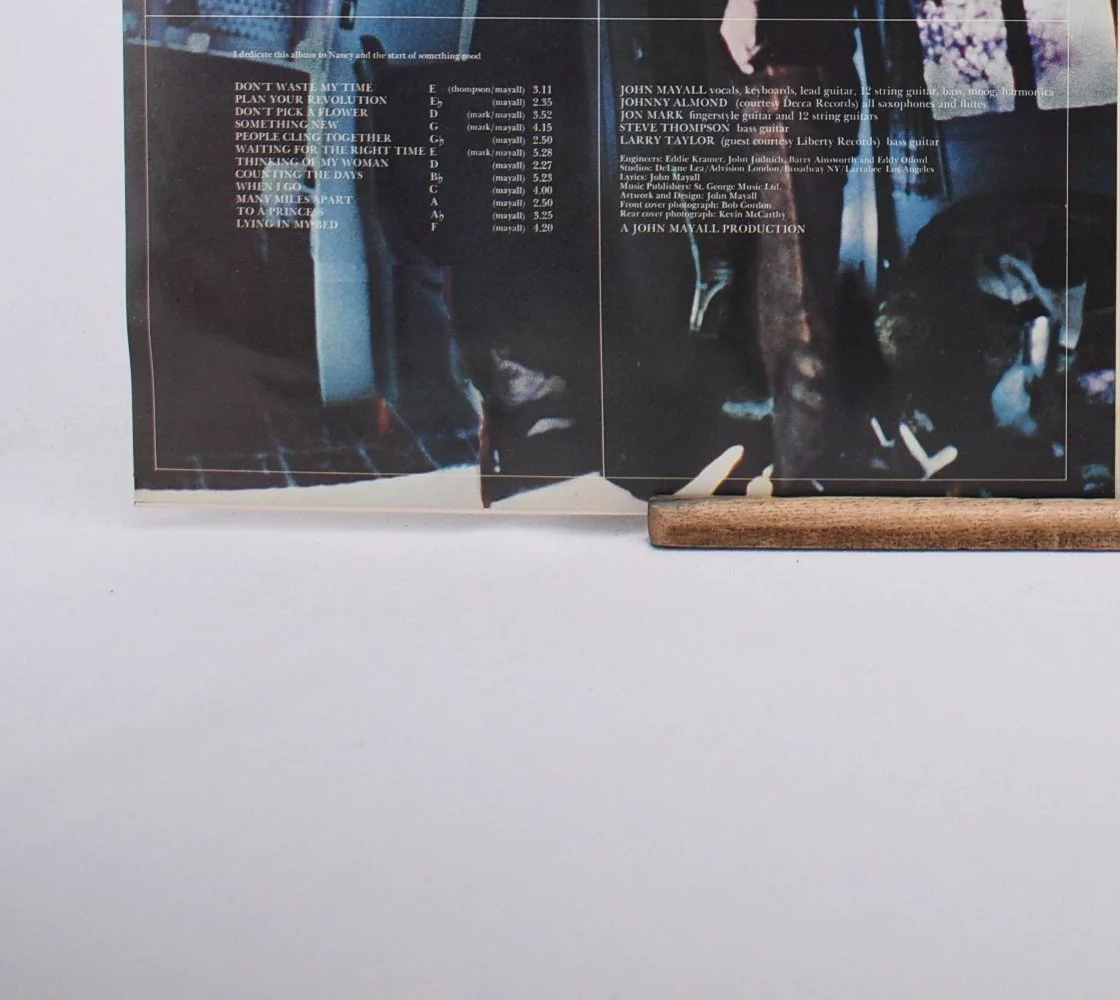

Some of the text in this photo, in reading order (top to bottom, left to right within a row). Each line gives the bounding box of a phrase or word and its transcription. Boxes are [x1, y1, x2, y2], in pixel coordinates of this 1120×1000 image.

[235, 82, 552, 94] DON'T WASTE MY TIME E (thompson/mayall) 3.11
[620, 85, 652, 95] JOHN
[656, 85, 707, 95] MAYALL
[799, 86, 820, 96] lead
[235, 95, 266, 104] PLAN
[269, 95, 304, 104] YOUR
[307, 95, 388, 104] REVOLUTION
[492, 98, 525, 108] (mayall)
[533, 98, 553, 107] 2.35
[235, 107, 553, 120] DON'T PICK A FLOWER D (mark/mayall) 3.52
[235, 120, 553, 133] SOMETHING NEW G (mark/mayall) 4.15
[619, 122, 790, 136] STEVE THOMPSON bass guitar
[620, 173, 647, 183] Lyrics:
[672, 173, 700, 183] Mayall
[620, 223, 806, 233] A JOHN MAYALL PRODUCTION
